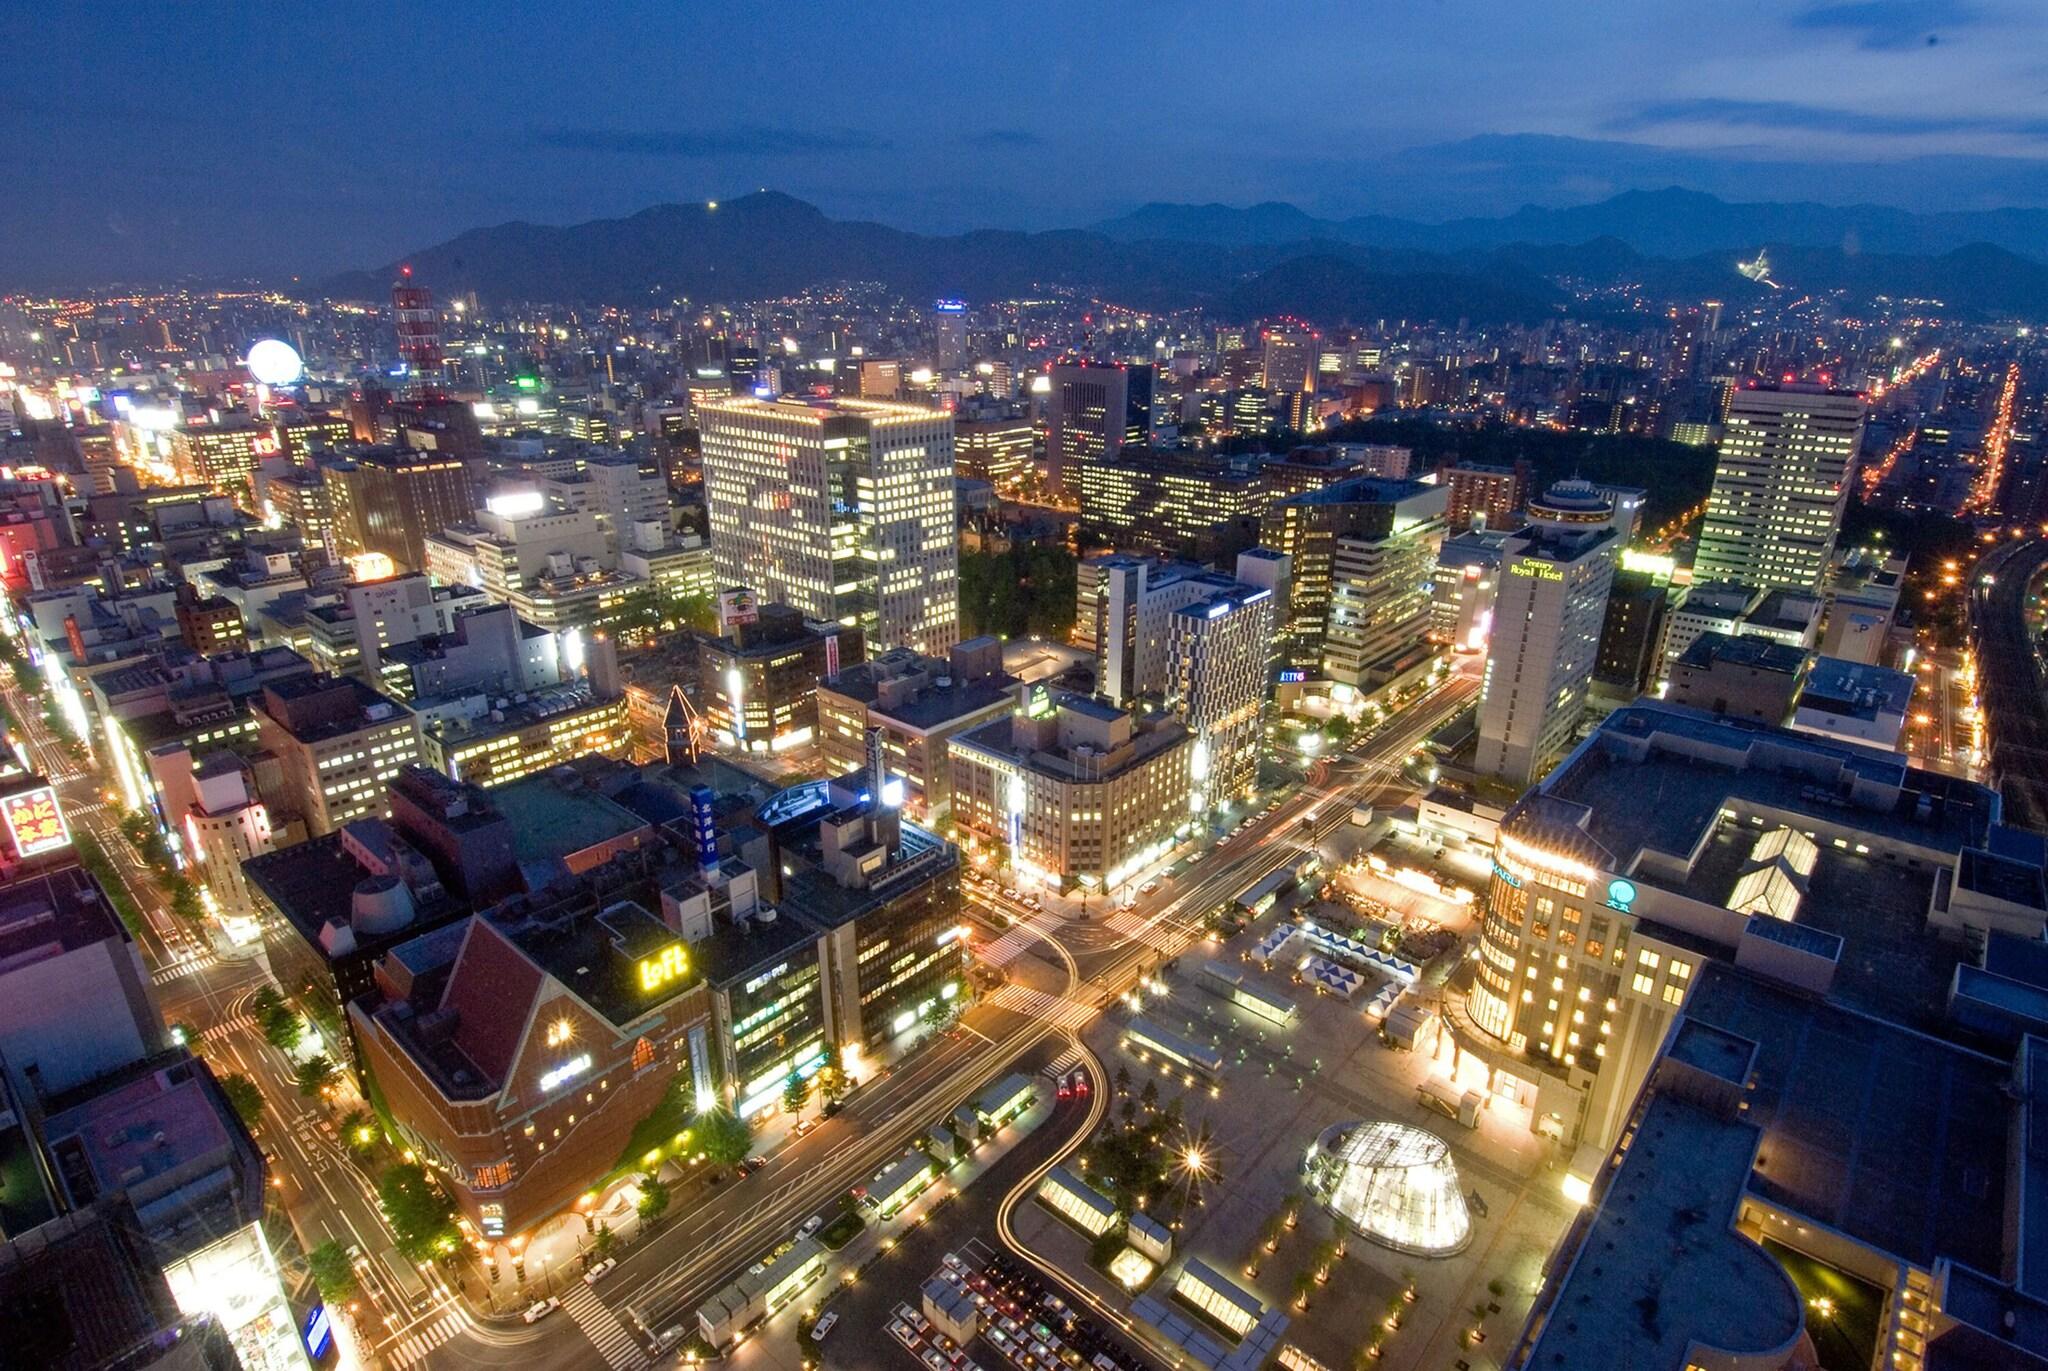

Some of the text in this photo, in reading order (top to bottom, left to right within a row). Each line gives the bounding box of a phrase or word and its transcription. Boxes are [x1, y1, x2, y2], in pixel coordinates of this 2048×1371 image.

[1511, 564, 1563, 581] Royal Hotel
[1523, 558, 1554, 571] Century
[11, 800, 56, 826] かに
[702, 803, 716, 853] 北洋銀行
[1606, 899, 1630, 913] 大丸
